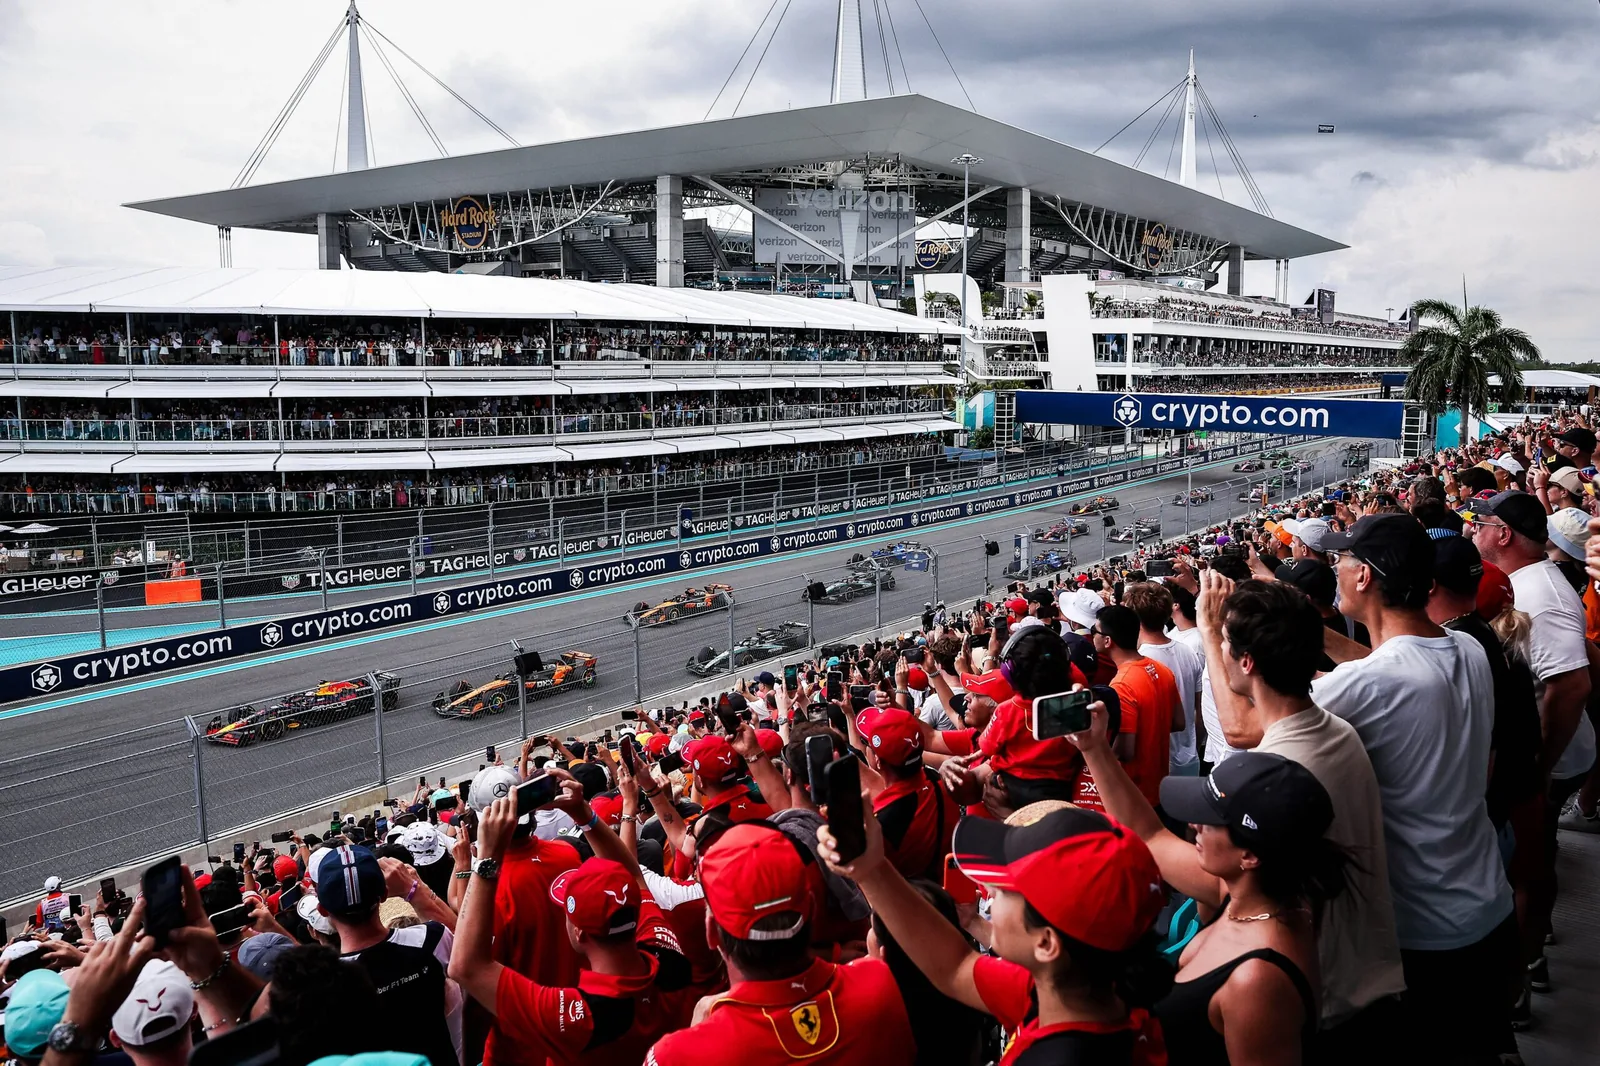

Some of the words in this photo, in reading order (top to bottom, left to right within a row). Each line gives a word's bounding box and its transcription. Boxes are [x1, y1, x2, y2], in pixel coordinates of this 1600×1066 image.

[793, 189, 910, 211] verizon
[440, 208, 467, 228] Hard
[468, 205, 497, 228] Rock
[763, 207, 797, 216] erizon
[816, 208, 842, 217] veriz
[871, 210, 909, 219] verizon
[461, 231, 482, 239] STADIUM
[857, 223, 881, 233] rizon
[759, 236, 797, 246] verizon
[816, 238, 843, 247] veriz
[1142, 230, 1158, 248] Hard
[787, 252, 825, 261] verizon
[1151, 401, 1329, 428] crypto.com
[1213, 447, 1234, 460] crypto.com
[1132, 467, 1154, 479] crypto.com
[1161, 461, 1181, 473] crypto.com
[1100, 472, 1124, 485] crypto.com
[1063, 480, 1090, 493] crypto.com
[1022, 488, 1052, 502] crypto.com
[975, 496, 1010, 511] crypto.com
[920, 506, 960, 523] crypto.com
[692, 518, 730, 535] AGHeue
[857, 516, 904, 534] crypto.com
[783, 528, 838, 548] crypto.com
[695, 542, 759, 564] crypto.com
[588, 558, 666, 582] crypto.com
[0, 574, 93, 595] GHeuer
[457, 577, 552, 606] crypto.com
[291, 602, 411, 637] crypto.com
[73, 636, 232, 679] crypto.com
[400, 972, 419, 984] Team
[574, 1000, 584, 1020] aws
